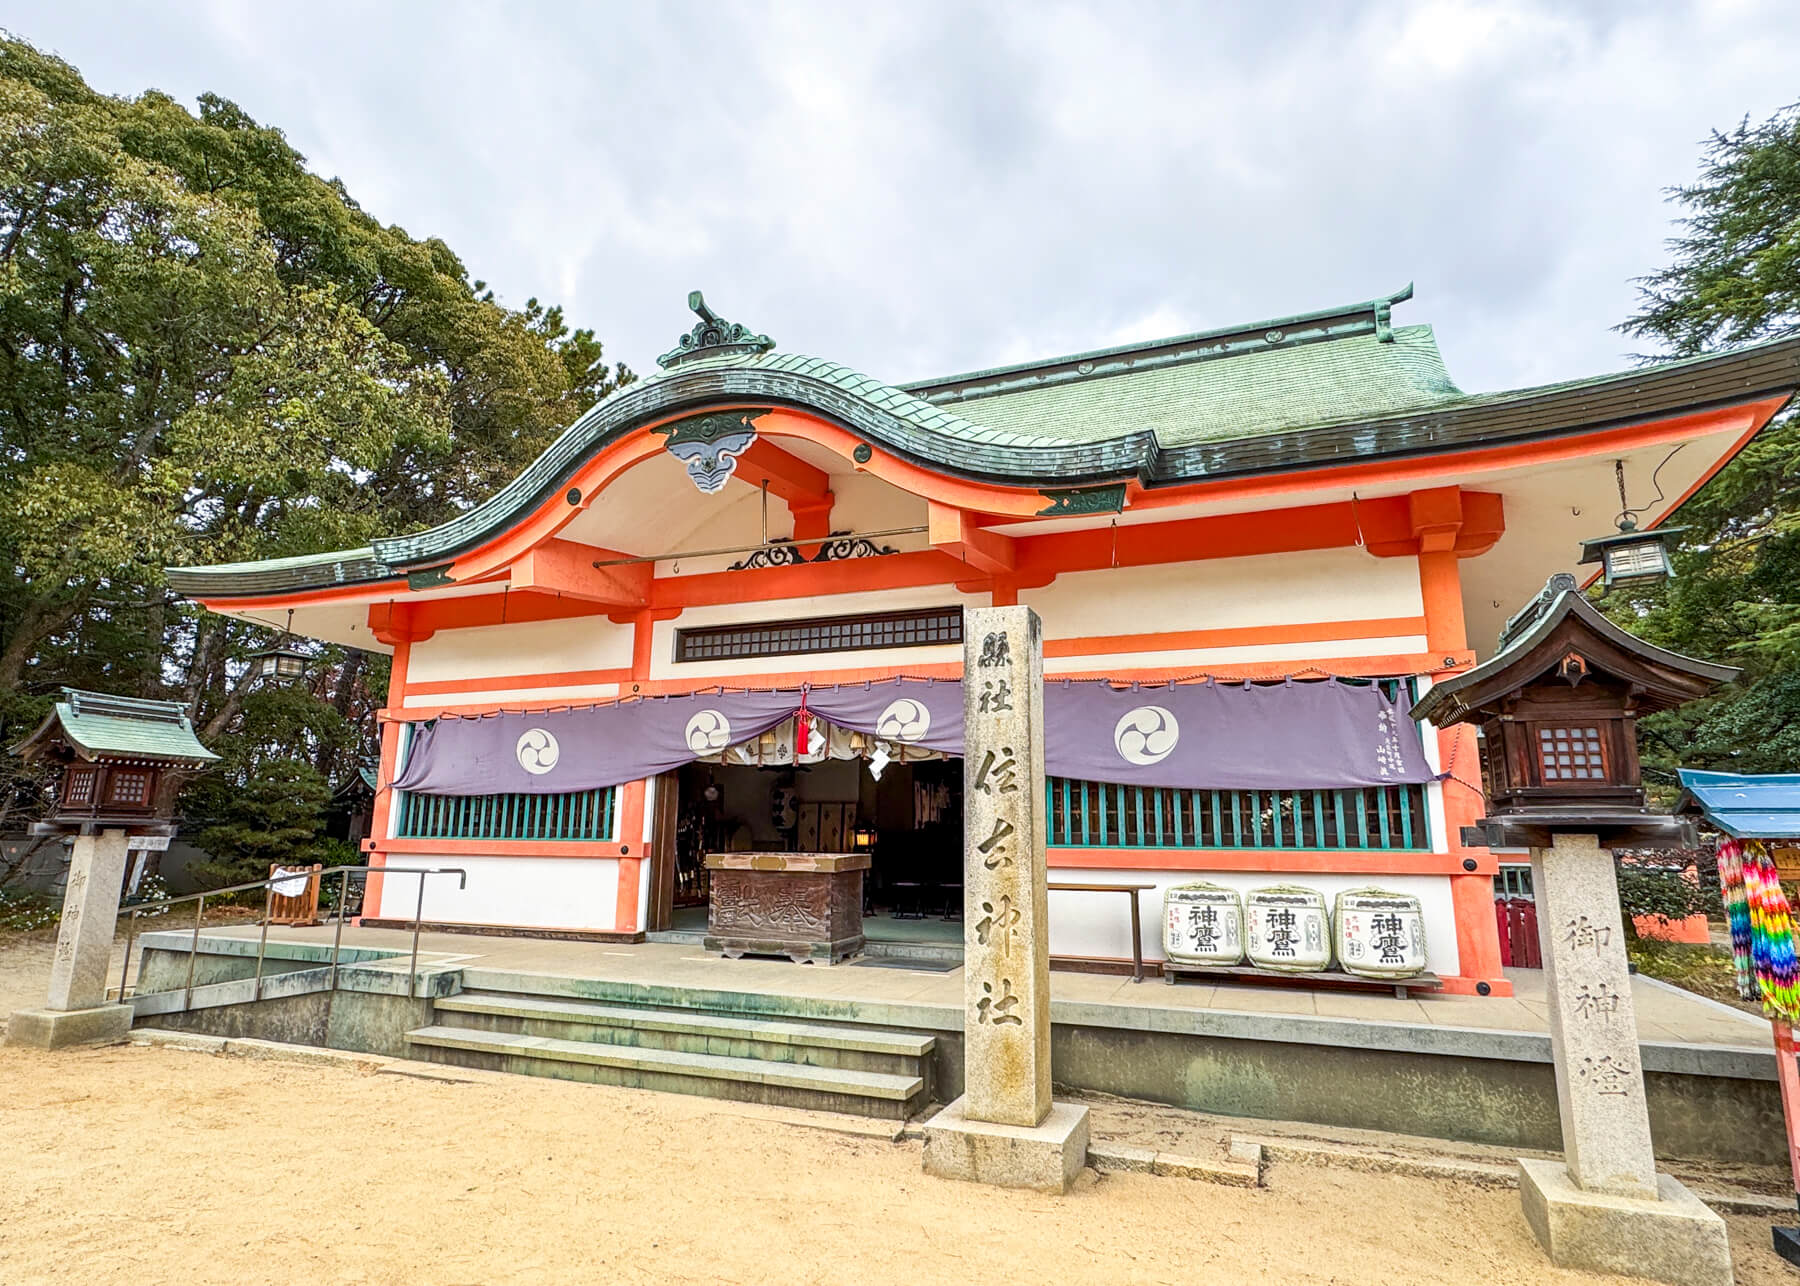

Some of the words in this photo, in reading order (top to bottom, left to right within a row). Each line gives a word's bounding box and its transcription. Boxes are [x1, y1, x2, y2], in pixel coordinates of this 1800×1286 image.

[974, 747, 1022, 1026] 住吉神社
[1188, 905, 1222, 952] 神鷹
[1266, 908, 1299, 957] 神鷹
[1370, 912, 1407, 964] 神鷹
[1563, 915, 1631, 1097] 御神燈
